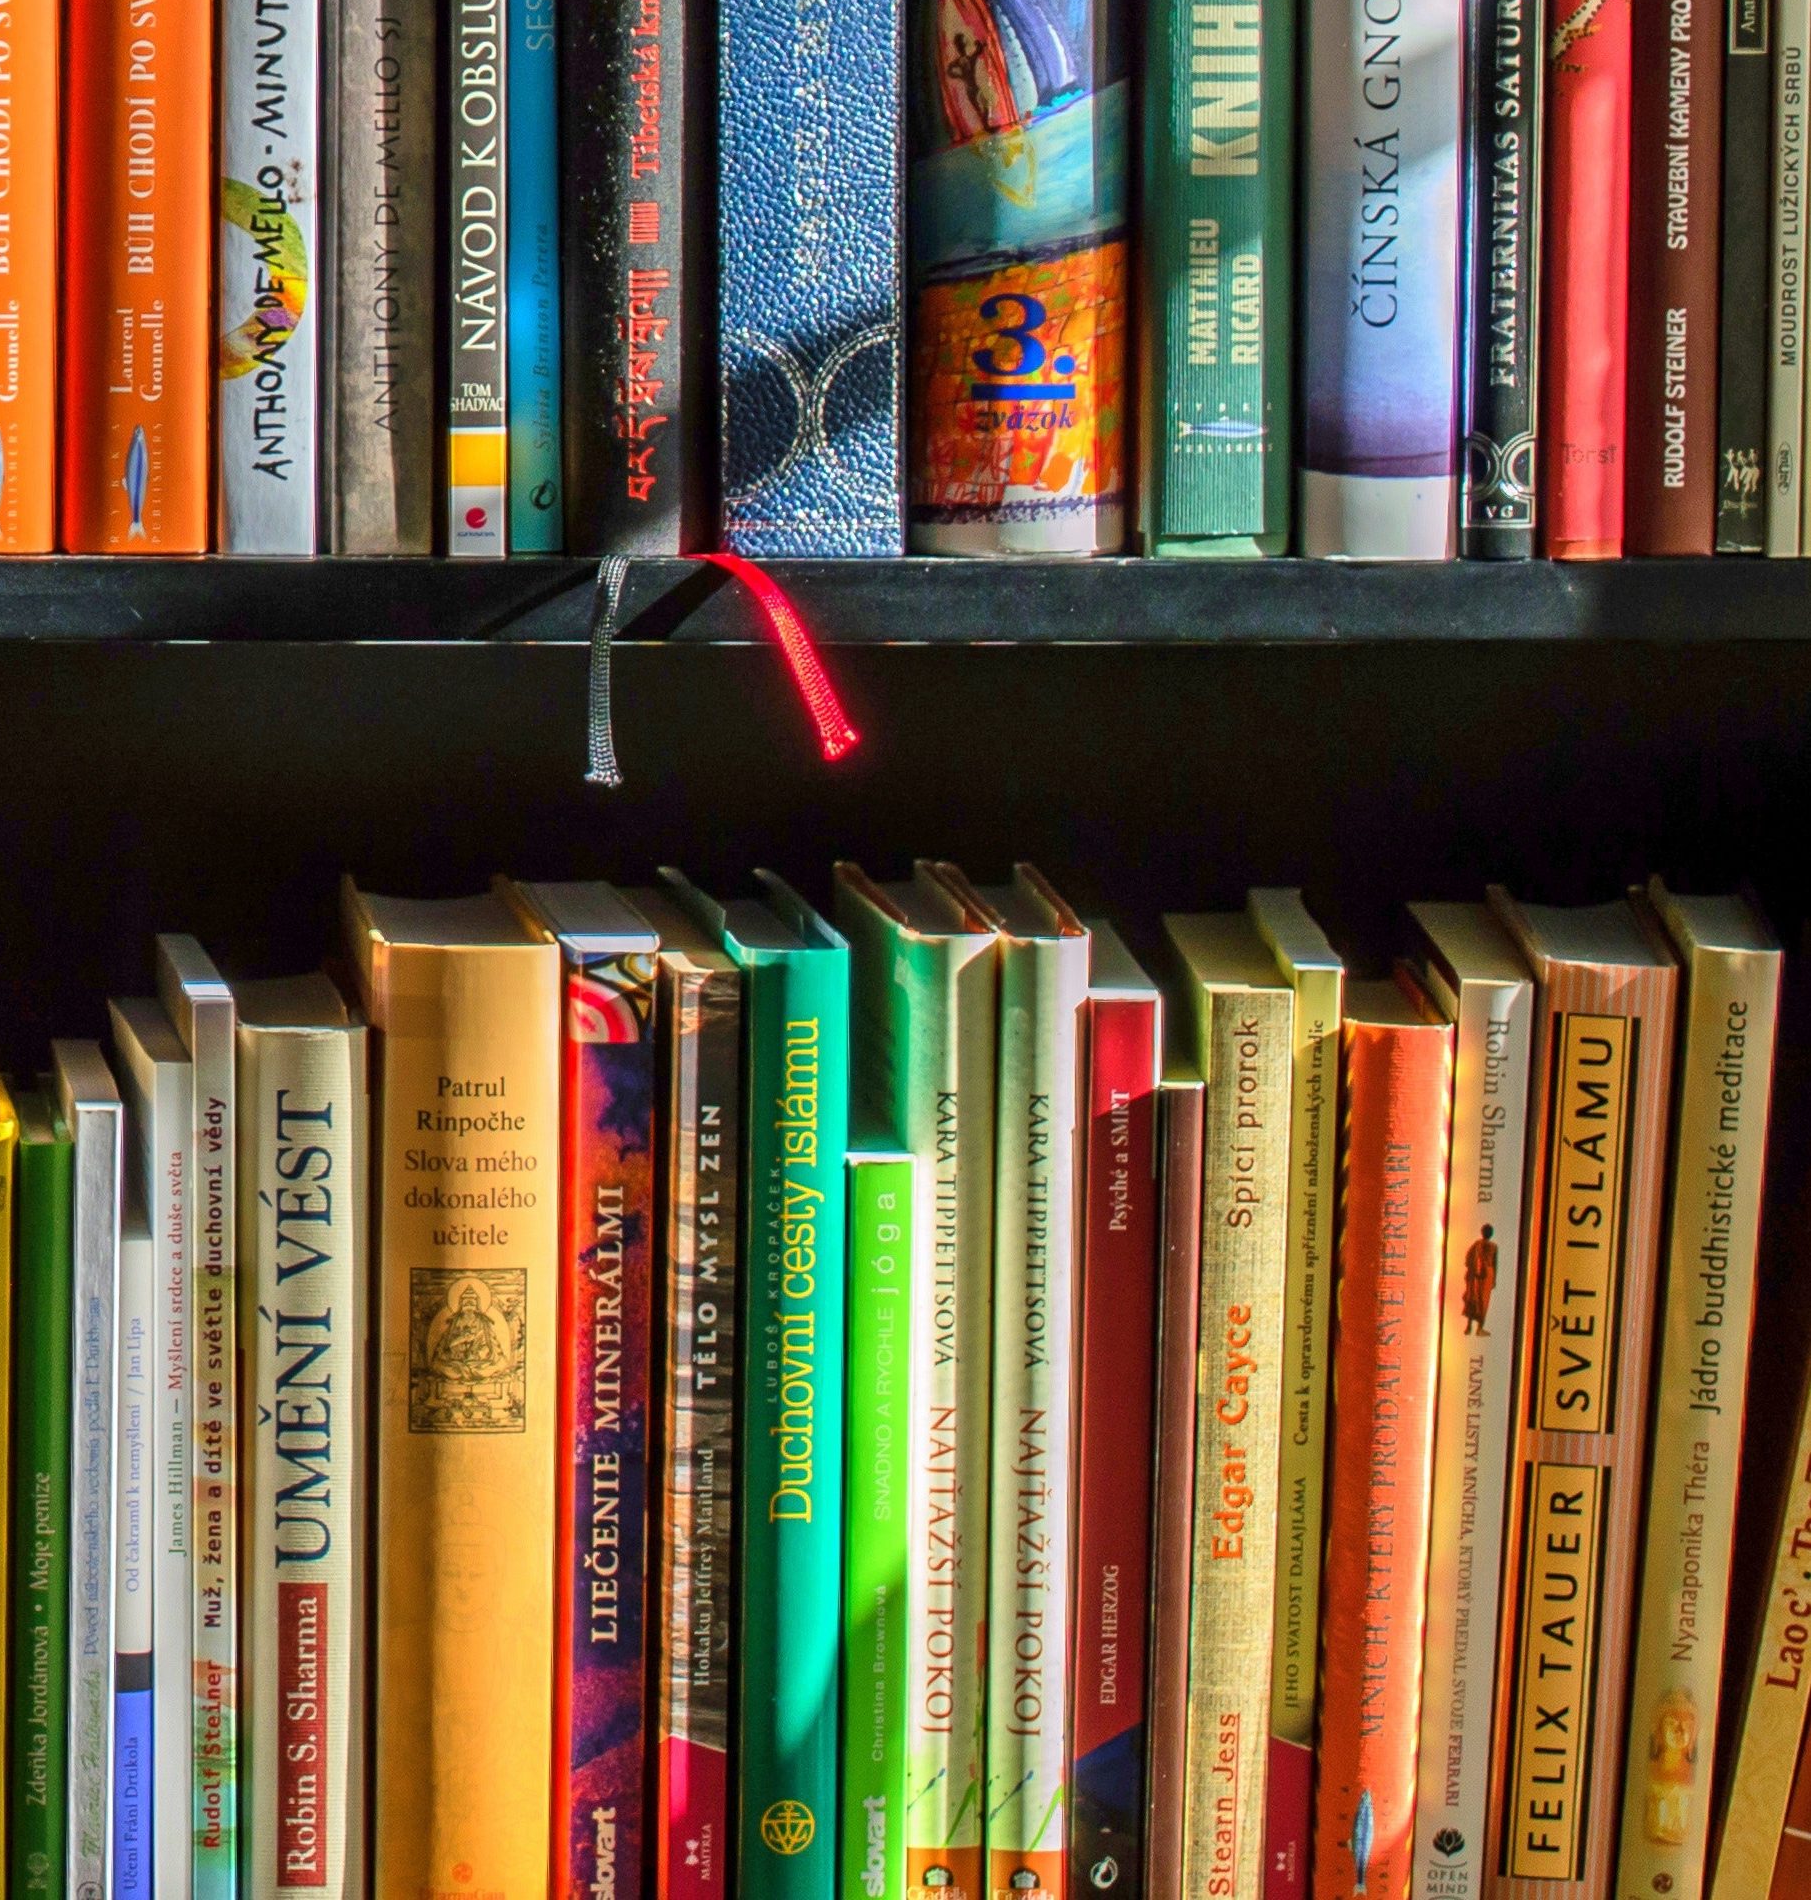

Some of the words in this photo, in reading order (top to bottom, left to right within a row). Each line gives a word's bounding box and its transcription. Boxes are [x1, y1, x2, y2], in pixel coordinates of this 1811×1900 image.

[460, 136, 495, 166] K
[1352, 129, 1402, 329] ČÍNSKÁ
[455, 185, 497, 352] NÁVOD
[772, 1017, 821, 1166] islámu
[1567, 1033, 1614, 1250] ISLÁMU
[259, 1089, 332, 1285] VÉST
[780, 1181, 825, 1301] cesty
[587, 1185, 627, 1431] MINERÁLMI
[1214, 1304, 1254, 1426] Cayce
[1552, 1280, 1596, 1413] SVĚT
[258, 1305, 333, 1568] UMĚNÍ
[769, 1312, 817, 1523] Duchovní
[1212, 1444, 1255, 1560] Edgar
[587, 1451, 622, 1644] LIEČENIE
[1539, 1488, 1585, 1675] TAUER
[1527, 1706, 1569, 1854] FELIX
